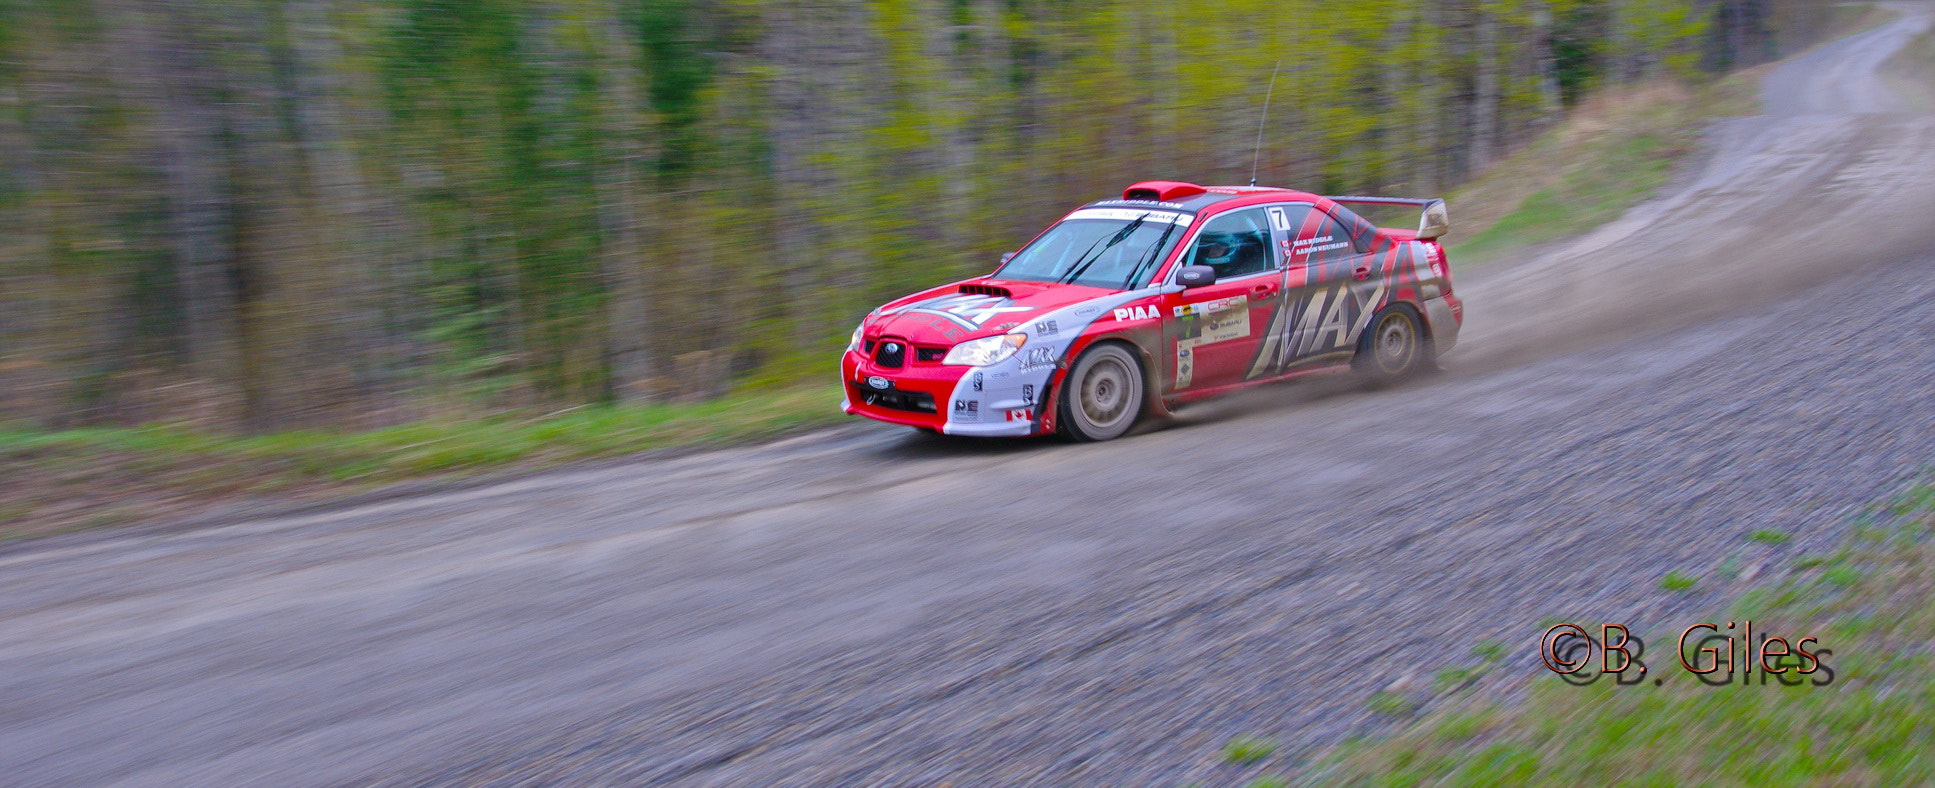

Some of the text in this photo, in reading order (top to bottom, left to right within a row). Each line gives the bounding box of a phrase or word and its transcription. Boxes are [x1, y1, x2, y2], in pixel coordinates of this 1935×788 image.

[1271, 209, 1283, 229] 7
[1113, 304, 1161, 322] PIAA
[1244, 280, 1385, 380] MAX
